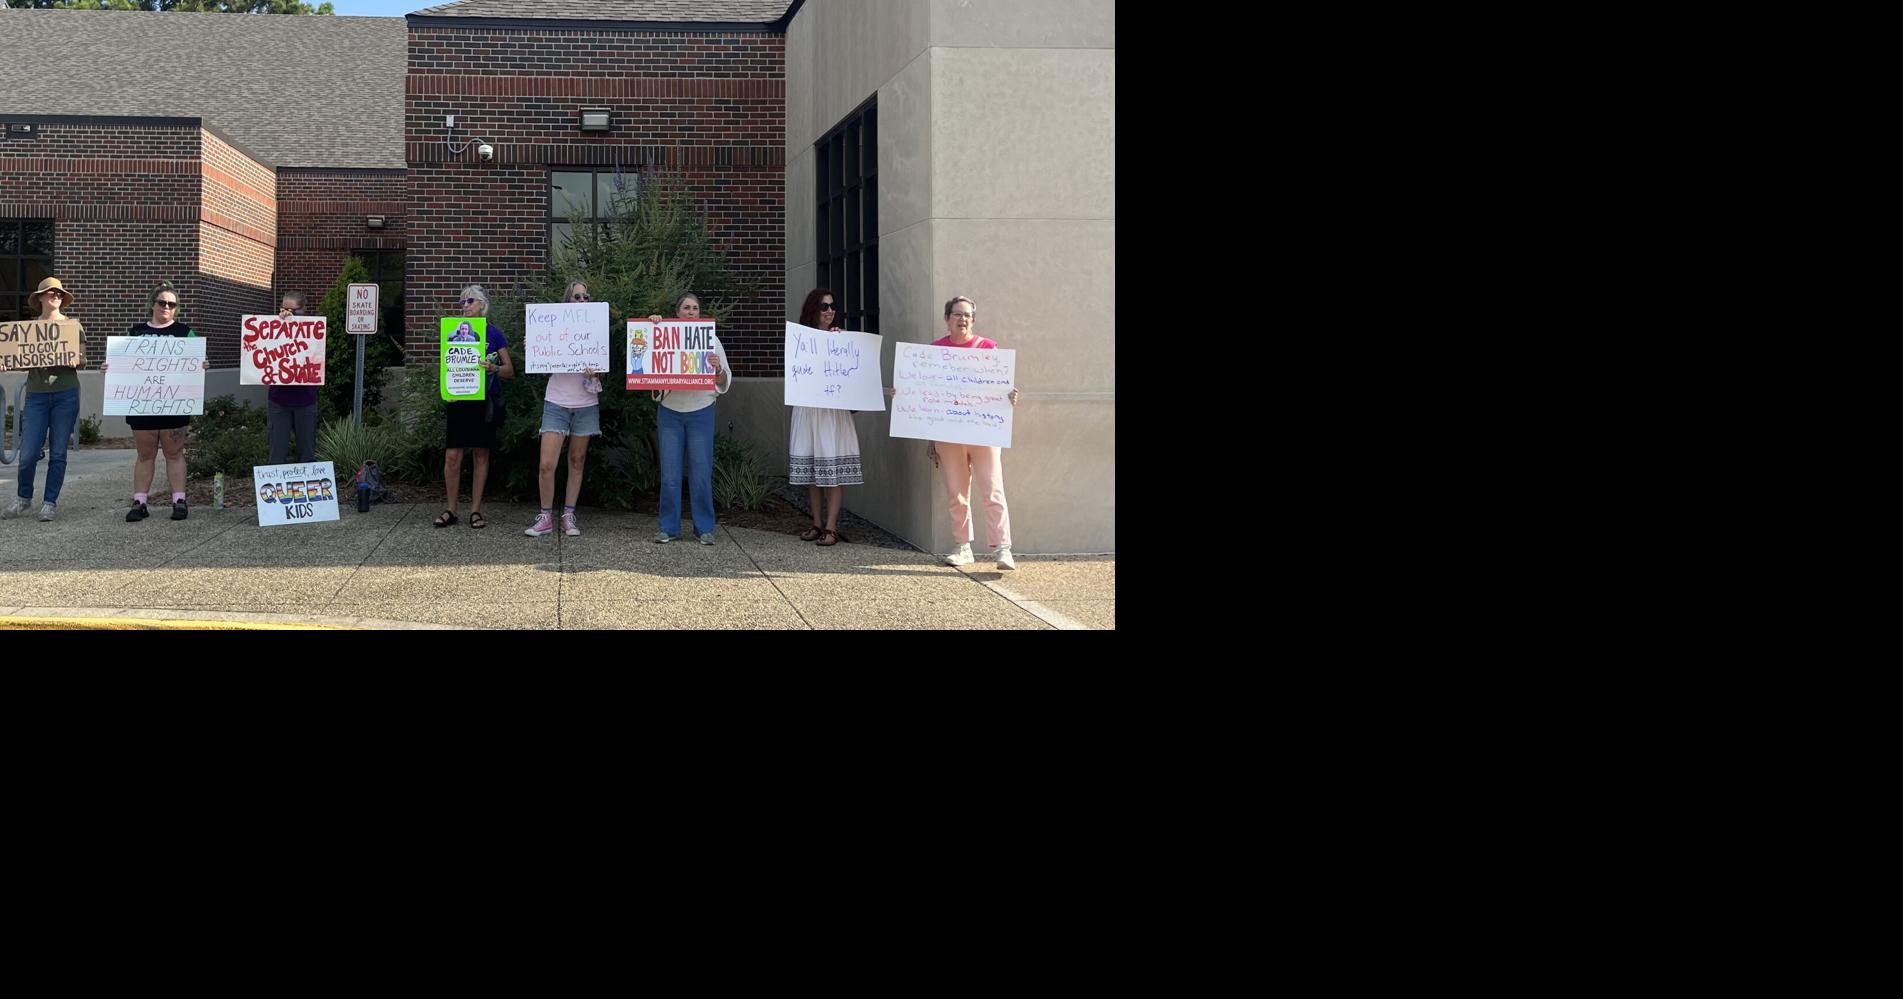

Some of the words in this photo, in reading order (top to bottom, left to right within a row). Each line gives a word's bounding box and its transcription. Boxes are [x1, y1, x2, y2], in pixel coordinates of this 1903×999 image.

[356, 289, 369, 300] NO
[528, 308, 557, 327] Keep
[0, 323, 32, 342] SAY
[35, 322, 60, 342] NO
[536, 330, 552, 342] out
[559, 328, 569, 341] of
[573, 331, 591, 342] our
[653, 326, 680, 350] BAN
[684, 326, 714, 350] HATE
[18, 343, 35, 353] TO
[124, 338, 186, 355] TRANS
[252, 339, 309, 369] Church
[448, 347, 473, 355] CADE
[533, 345, 562, 357] Public
[568, 341, 607, 356] Schools
[827, 338, 859, 358] literally
[0, 351, 76, 368] ENSORSHIP
[132, 357, 199, 372] RIGHTS
[446, 355, 481, 364] BRUMLEY
[651, 351, 675, 374] NOT
[824, 360, 851, 377] Hitler
[144, 376, 165, 384] ARE
[114, 385, 179, 399] HUMAN
[129, 399, 195, 414] RIGHTS
[312, 464, 326, 476] love
[260, 477, 334, 505] QUEER
[285, 503, 314, 520] KIDS
